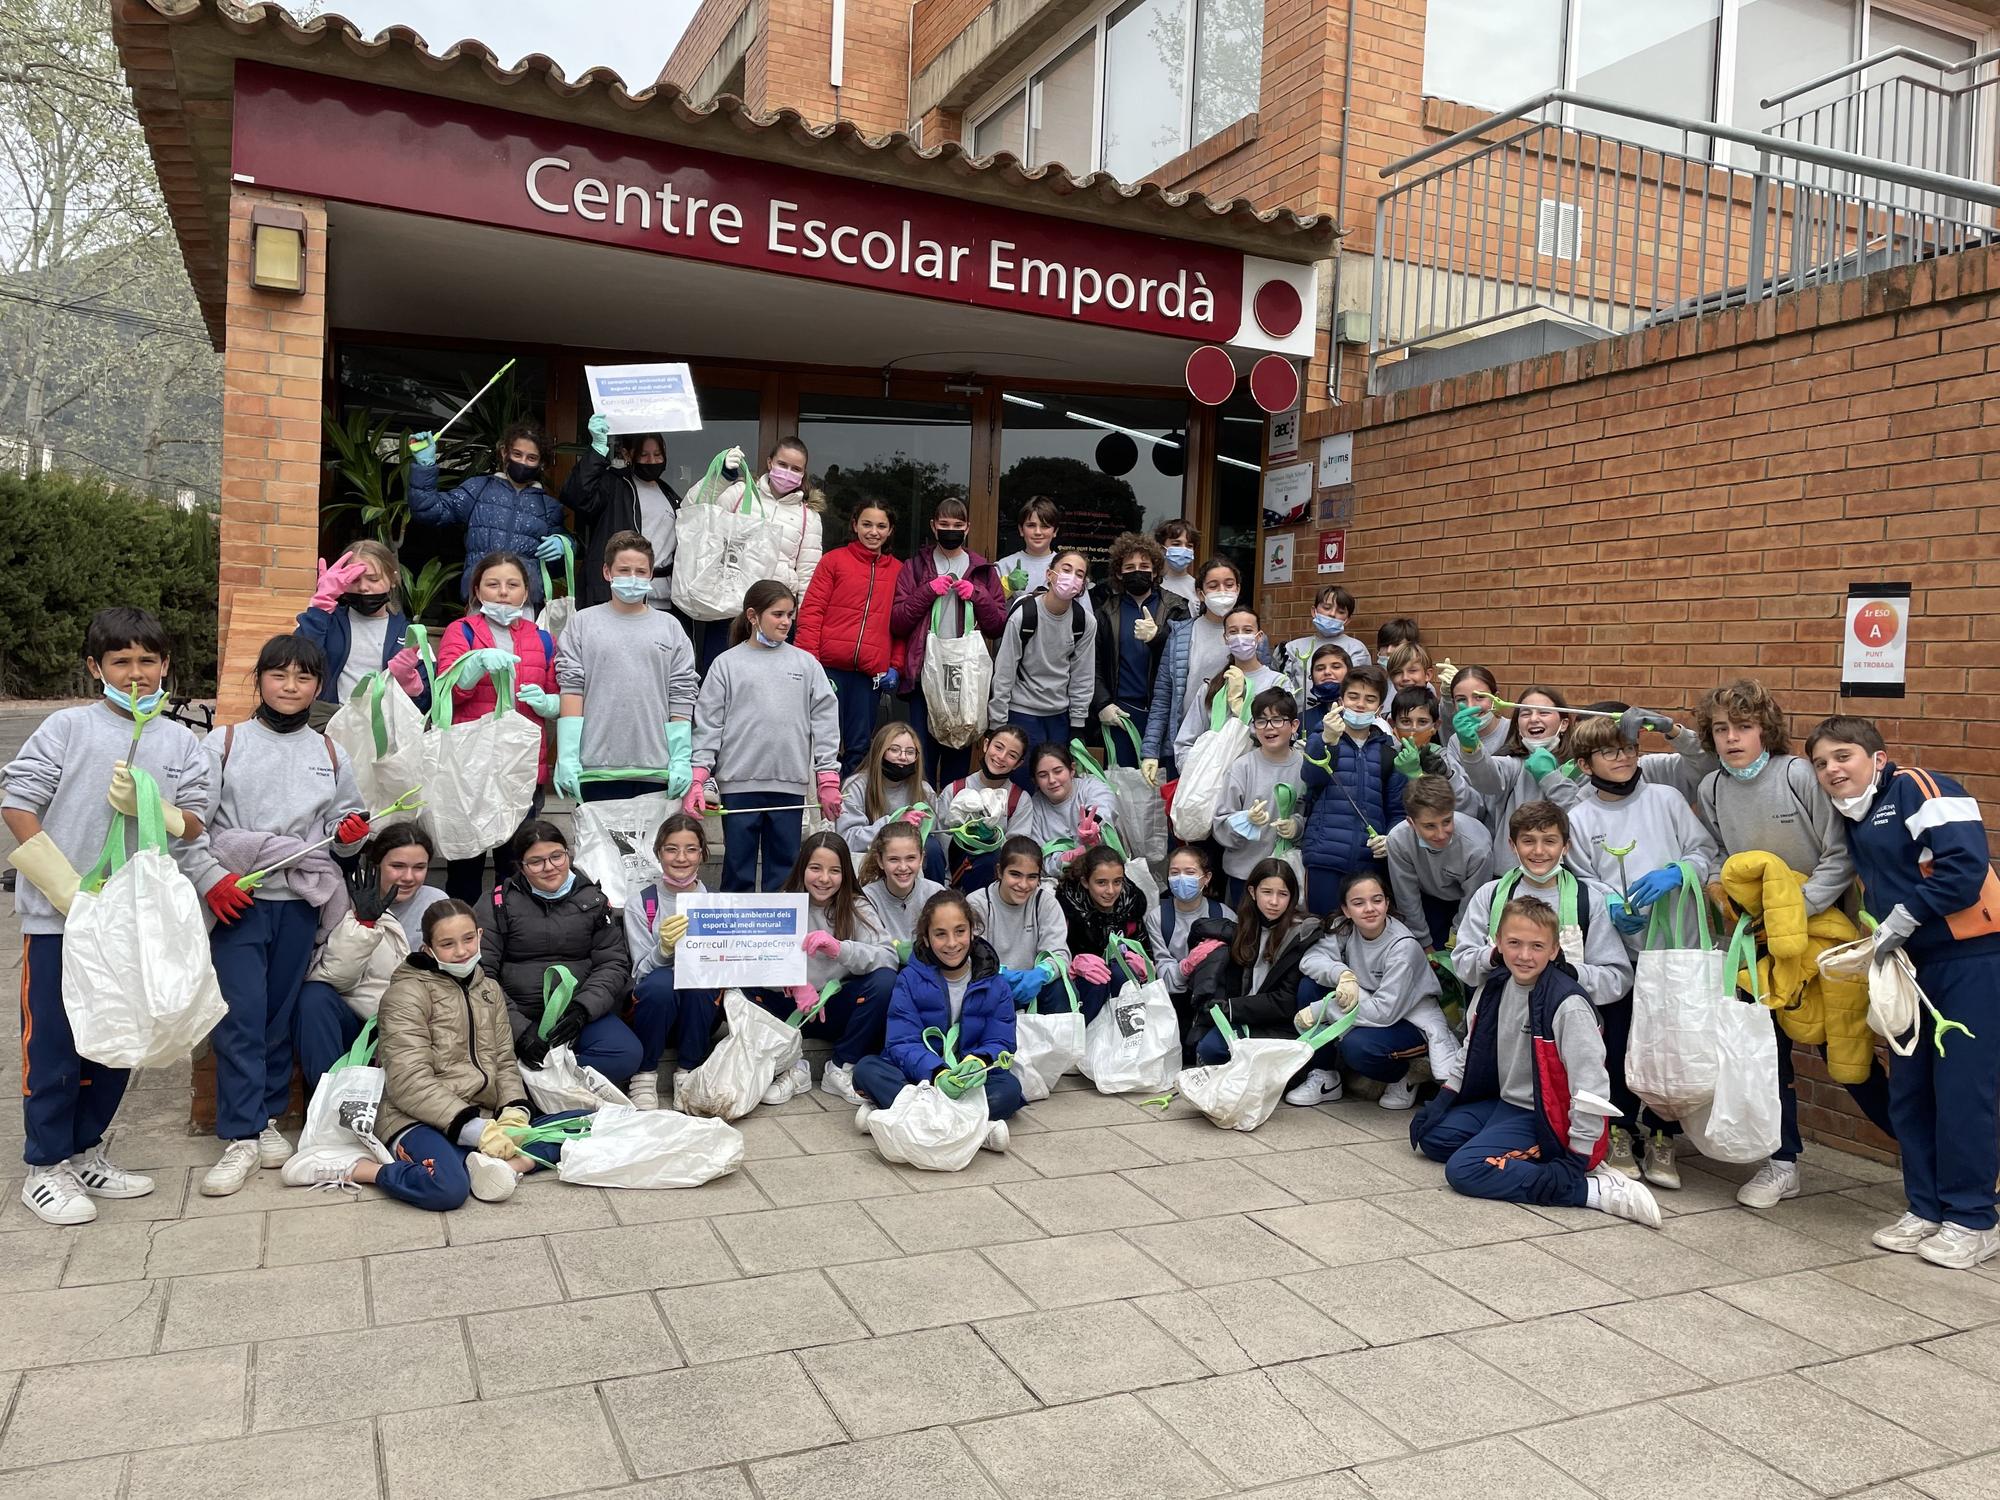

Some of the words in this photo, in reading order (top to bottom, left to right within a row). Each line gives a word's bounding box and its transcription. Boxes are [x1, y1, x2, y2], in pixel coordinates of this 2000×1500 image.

[525, 156, 745, 246] Centre
[767, 198, 972, 284] Escolar
[988, 238, 1217, 325] Empordà
[1874, 609, 1891, 617] ESO
[1869, 623, 1882, 639] A
[1853, 661, 1862, 669] DE
[1863, 661, 1895, 669] TROBADA
[693, 911, 700, 919] El
[741, 911, 776, 919] ambiental
[777, 911, 791, 919] dels
[702, 922, 729, 930] esports
[729, 921, 737, 929] al
[738, 921, 755, 929] medi
[756, 920, 782, 929] natural
[685, 939, 728, 950] Correcull
